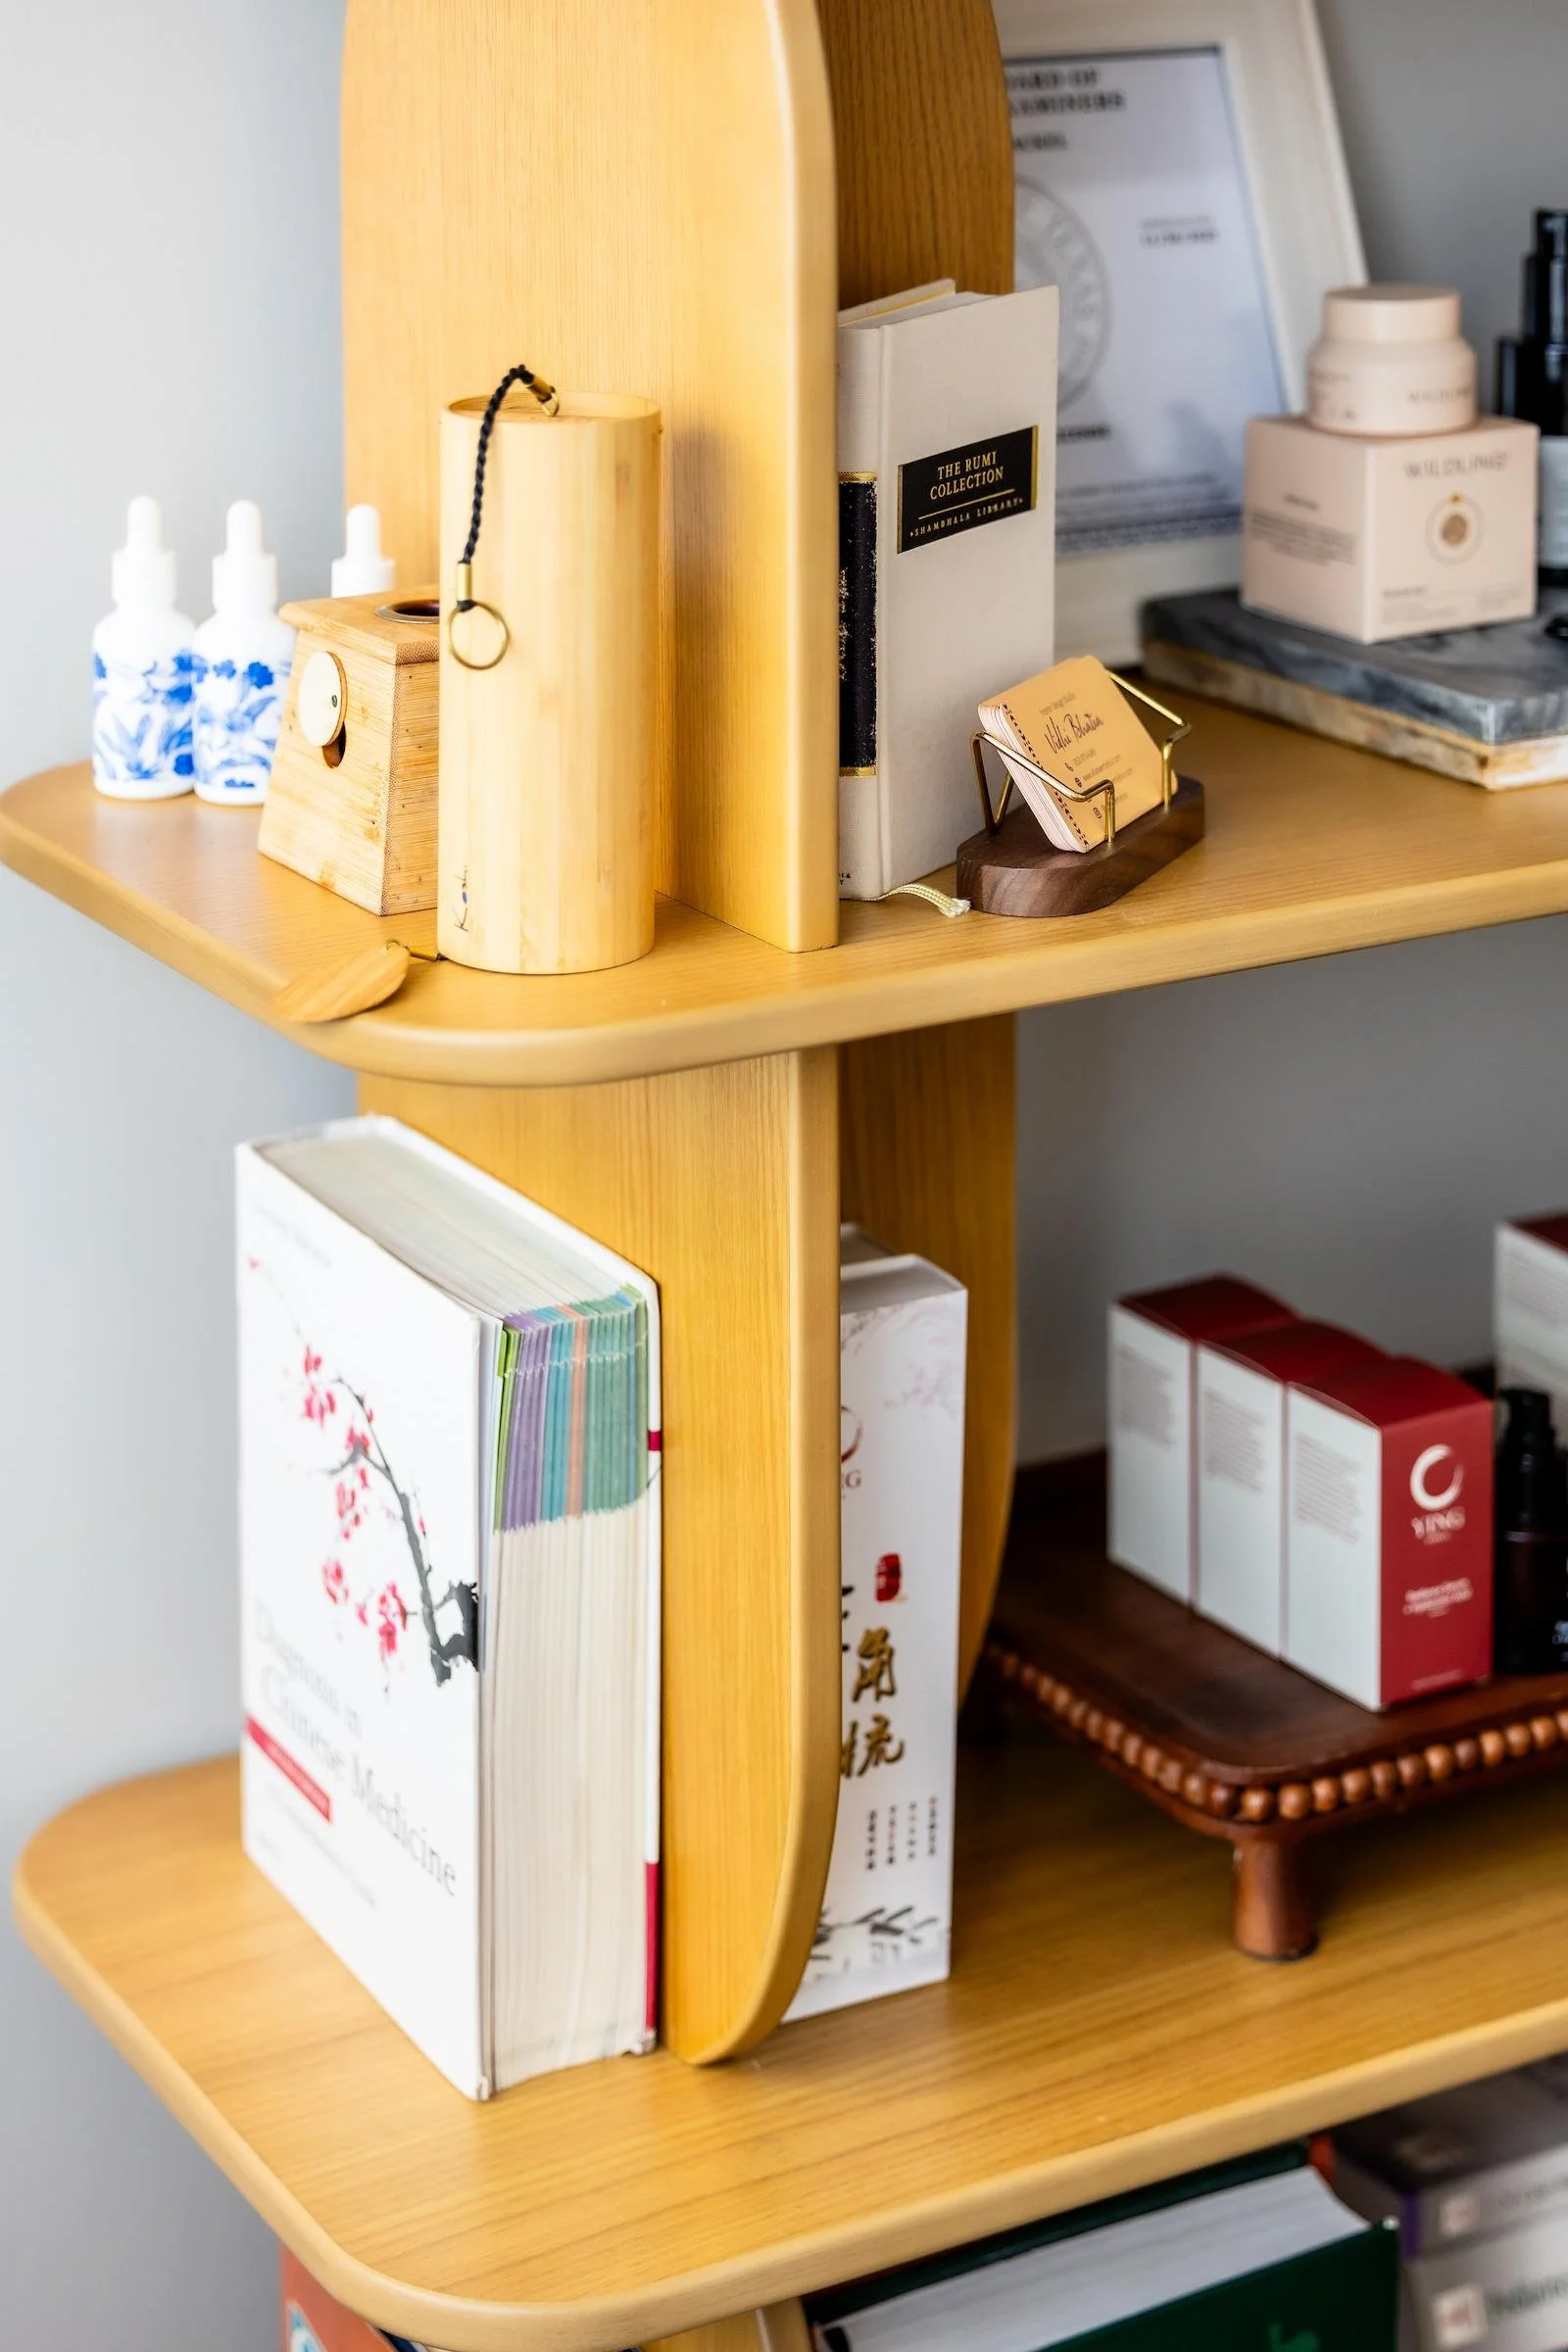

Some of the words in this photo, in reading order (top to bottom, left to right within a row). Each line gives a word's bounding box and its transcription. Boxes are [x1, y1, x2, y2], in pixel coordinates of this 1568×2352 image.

[937, 462, 961, 479] THE
[965, 451, 997, 471] RUMI
[930, 466, 1004, 500] COLLECTION
[977, 497, 1019, 517] LIBRARY
[1411, 1506, 1466, 1540] YING
[349, 1749, 457, 1898] Medicine
